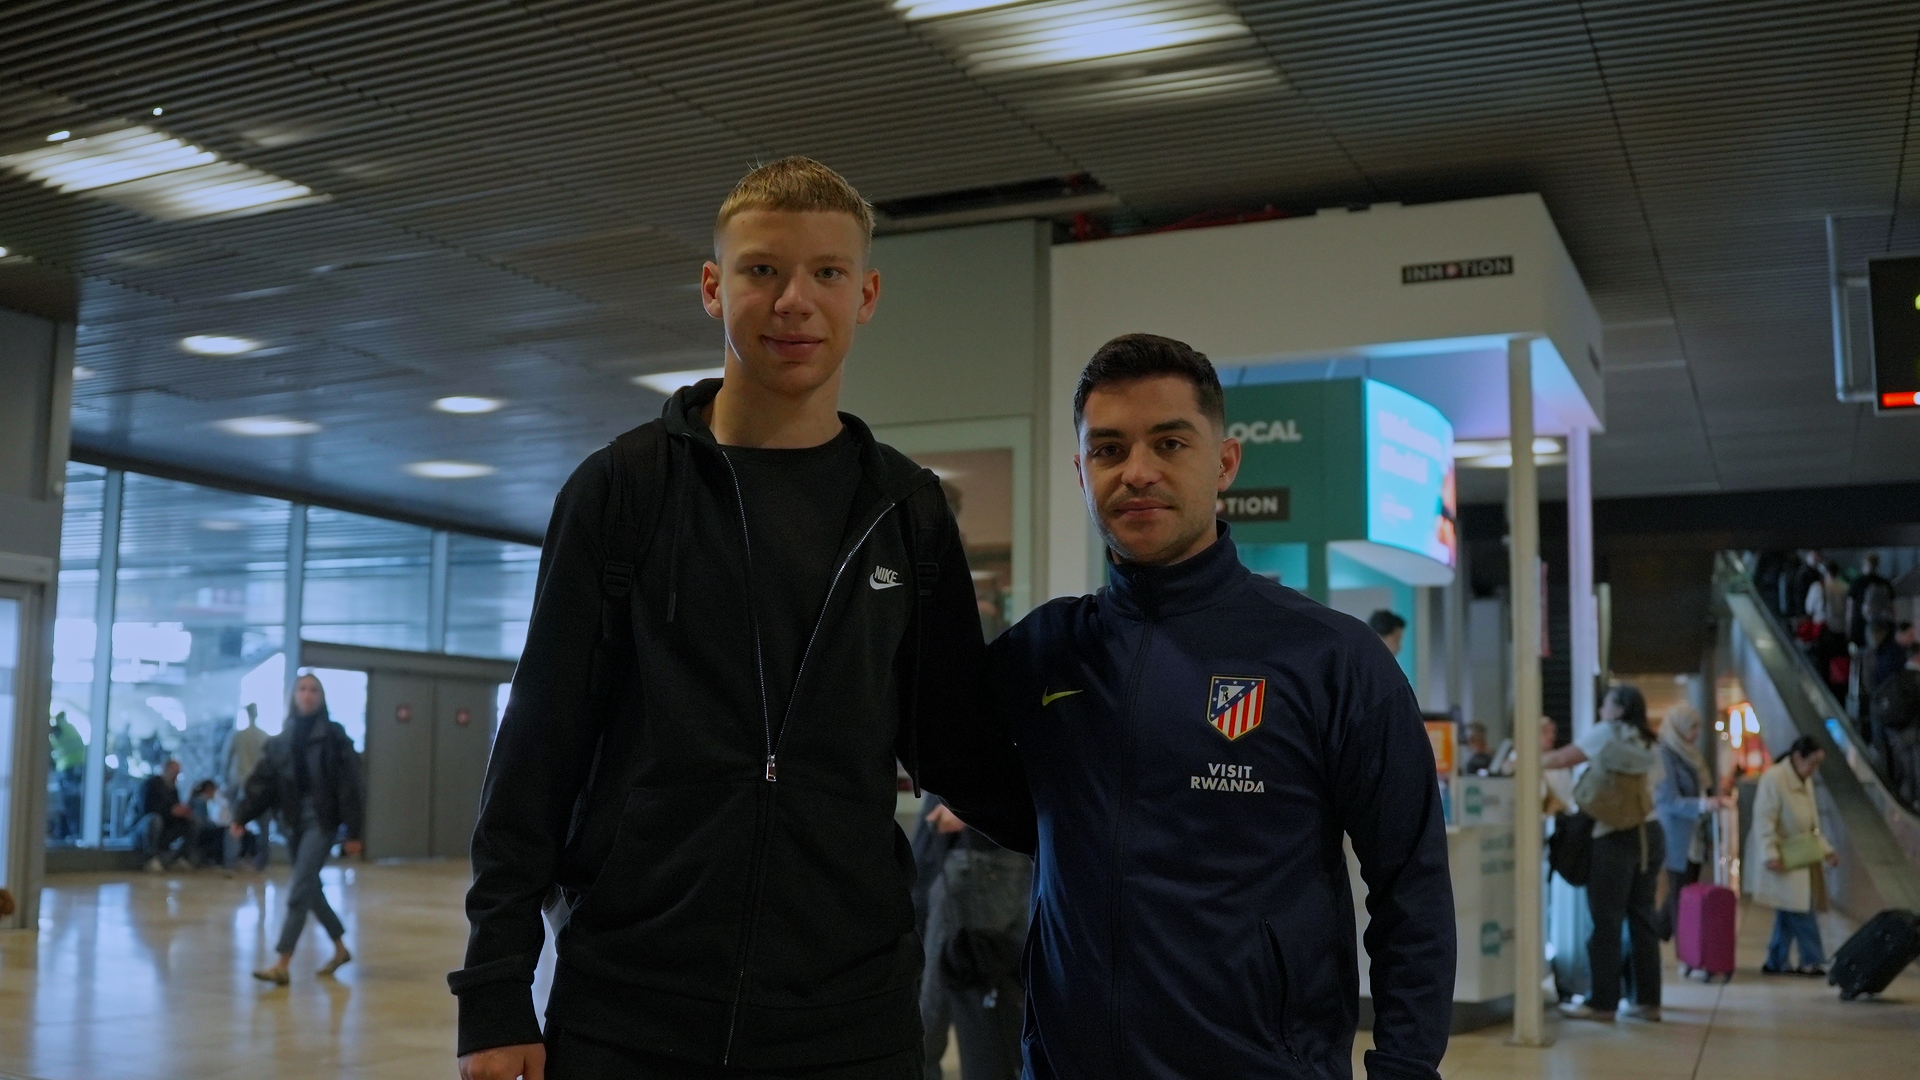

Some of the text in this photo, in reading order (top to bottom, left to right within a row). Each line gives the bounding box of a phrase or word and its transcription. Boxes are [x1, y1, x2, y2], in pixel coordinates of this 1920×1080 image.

[1226, 420, 1302, 443] OCAL
[874, 565, 899, 584] NIKE
[1208, 762, 1252, 779] VISIT
[1190, 776, 1265, 793] RWANDA
